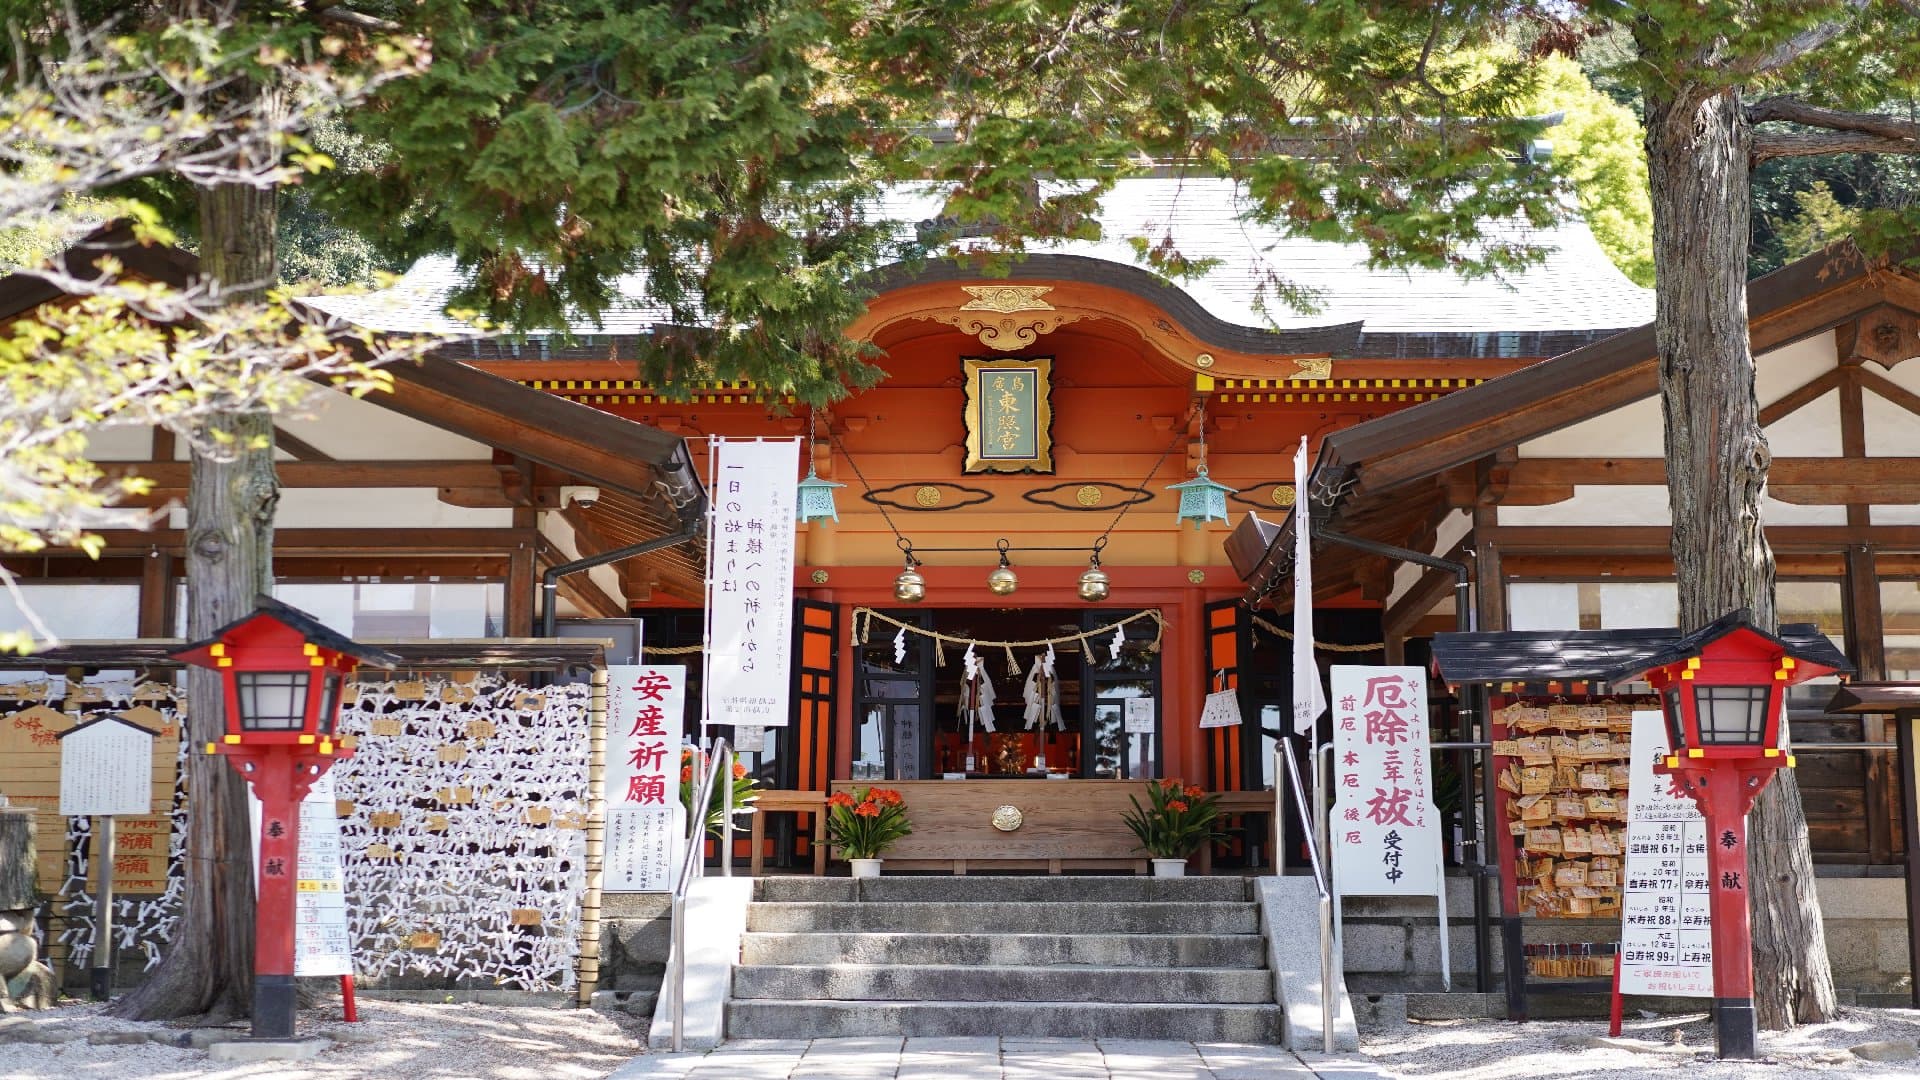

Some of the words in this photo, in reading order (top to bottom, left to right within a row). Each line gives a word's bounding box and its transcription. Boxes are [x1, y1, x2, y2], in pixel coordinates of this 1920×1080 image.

[997, 391, 1021, 450] 東照宮
[1407, 679, 1422, 740] やくよけ
[625, 670, 672, 806] 安産祈願
[1362, 674, 1415, 827] 厄除三年祓
[1339, 694, 1362, 845] 前厄・本厄・後厄
[117, 833, 153, 849] 祈願
[265, 820, 286, 876] 奉献
[1382, 829, 1404, 885] 受付中
[1630, 844, 1659, 854] 還暦祝
[1686, 844, 1708, 854] 古稀
[115, 859, 150, 874] 祈願
[1719, 829, 1742, 891] 奉献
[1627, 915, 1656, 925] 米寿祝
[1657, 932, 1672, 940] 大正
[1625, 951, 1655, 961] 白寿祝
[1681, 952, 1711, 963] 上寿祝
